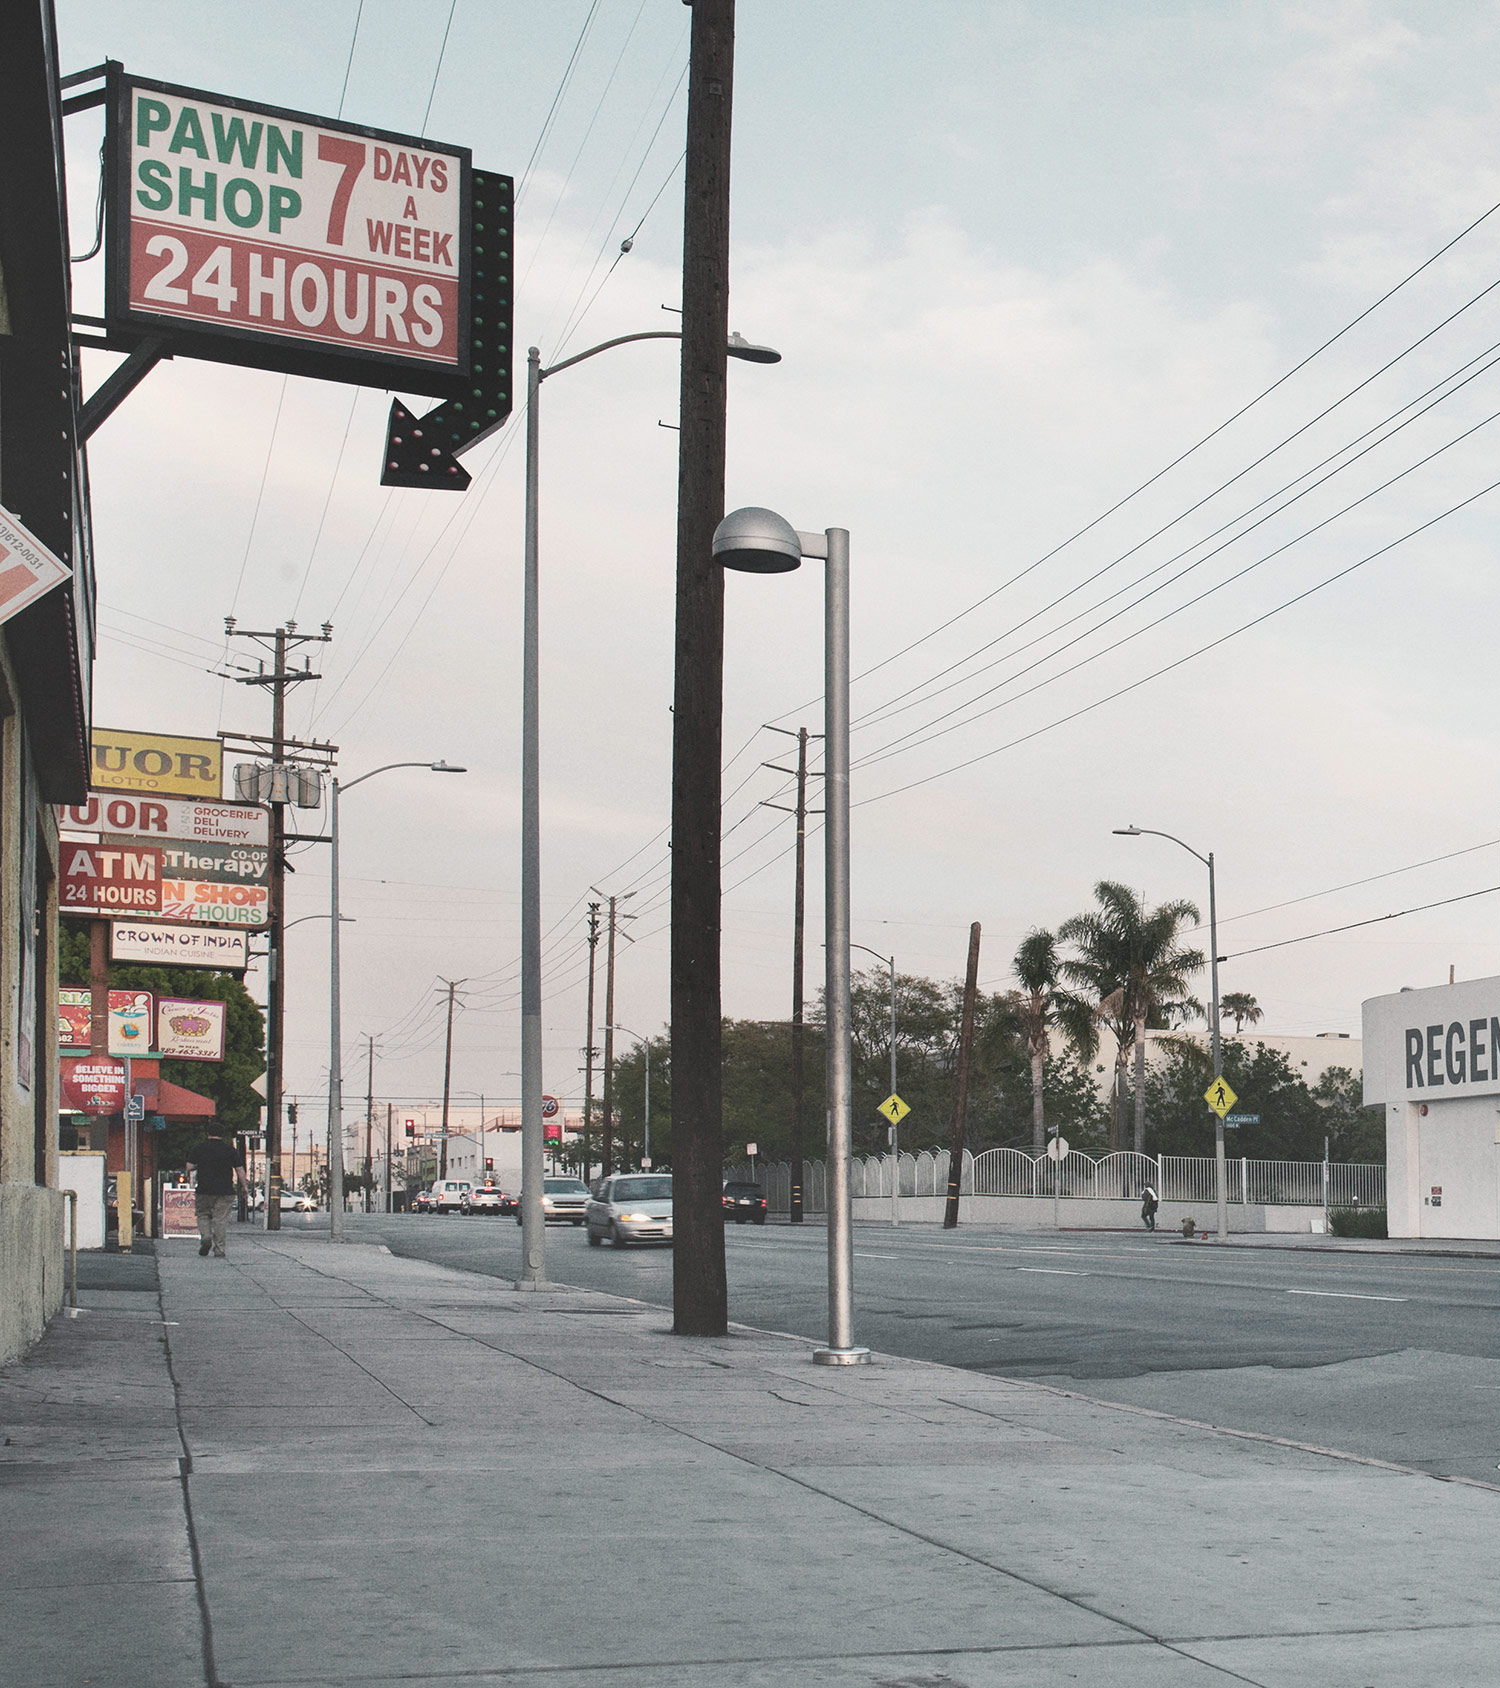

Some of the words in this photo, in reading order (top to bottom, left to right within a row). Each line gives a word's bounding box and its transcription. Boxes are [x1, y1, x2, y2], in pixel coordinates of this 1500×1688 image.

[136, 96, 303, 179] PAWN
[373, 146, 448, 193] DAYS
[136, 159, 302, 234] SHOP
[318, 134, 366, 246] 7
[402, 195, 418, 221] A
[366, 218, 453, 267] WEEK
[143, 234, 238, 313] 24
[249, 252, 444, 348] HOURS
[101, 774, 159, 788] LOTTO
[60, 797, 168, 832] UOR
[194, 807, 262, 820] GROCERIES
[194, 817, 219, 827] DELI
[194, 827, 250, 839] DELIVERY
[67, 850, 156, 881] ATM
[231, 850, 268, 861] CO-OP
[65, 884, 88, 901] 24
[94, 886, 157, 906] HOURS
[162, 881, 185, 901] N
[194, 884, 267, 906] SHOP
[161, 902, 198, 919] 24
[200, 905, 262, 923] HOURS
[116, 930, 175, 945] CROWN
[179, 934, 200, 946] OF
[204, 936, 243, 949] INDIA
[144, 947, 177, 956] INDIAN
[180, 949, 215, 959] CUISINE
[75, 1065, 113, 1074] BELIEVE
[114, 1066, 124, 1074] IN
[81, 1083, 118, 1093] BIGGER.
